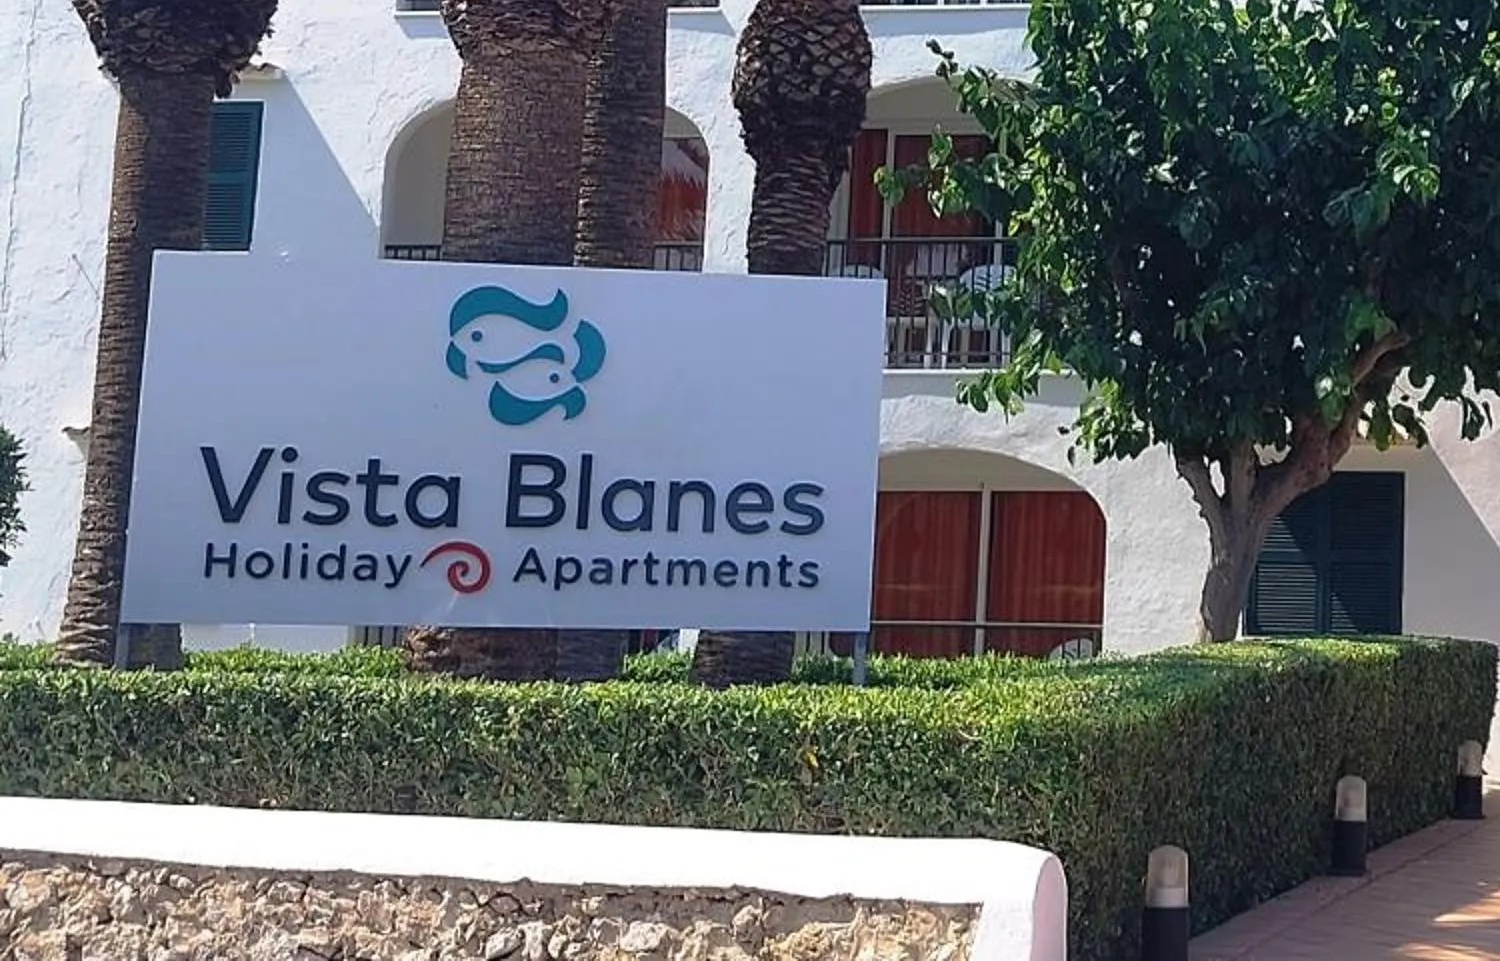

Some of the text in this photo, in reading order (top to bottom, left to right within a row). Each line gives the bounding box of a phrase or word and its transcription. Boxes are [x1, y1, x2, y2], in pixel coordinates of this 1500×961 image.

[199, 445, 826, 537] Vista Blanes
[203, 541, 820, 592] Holiday Apartments
